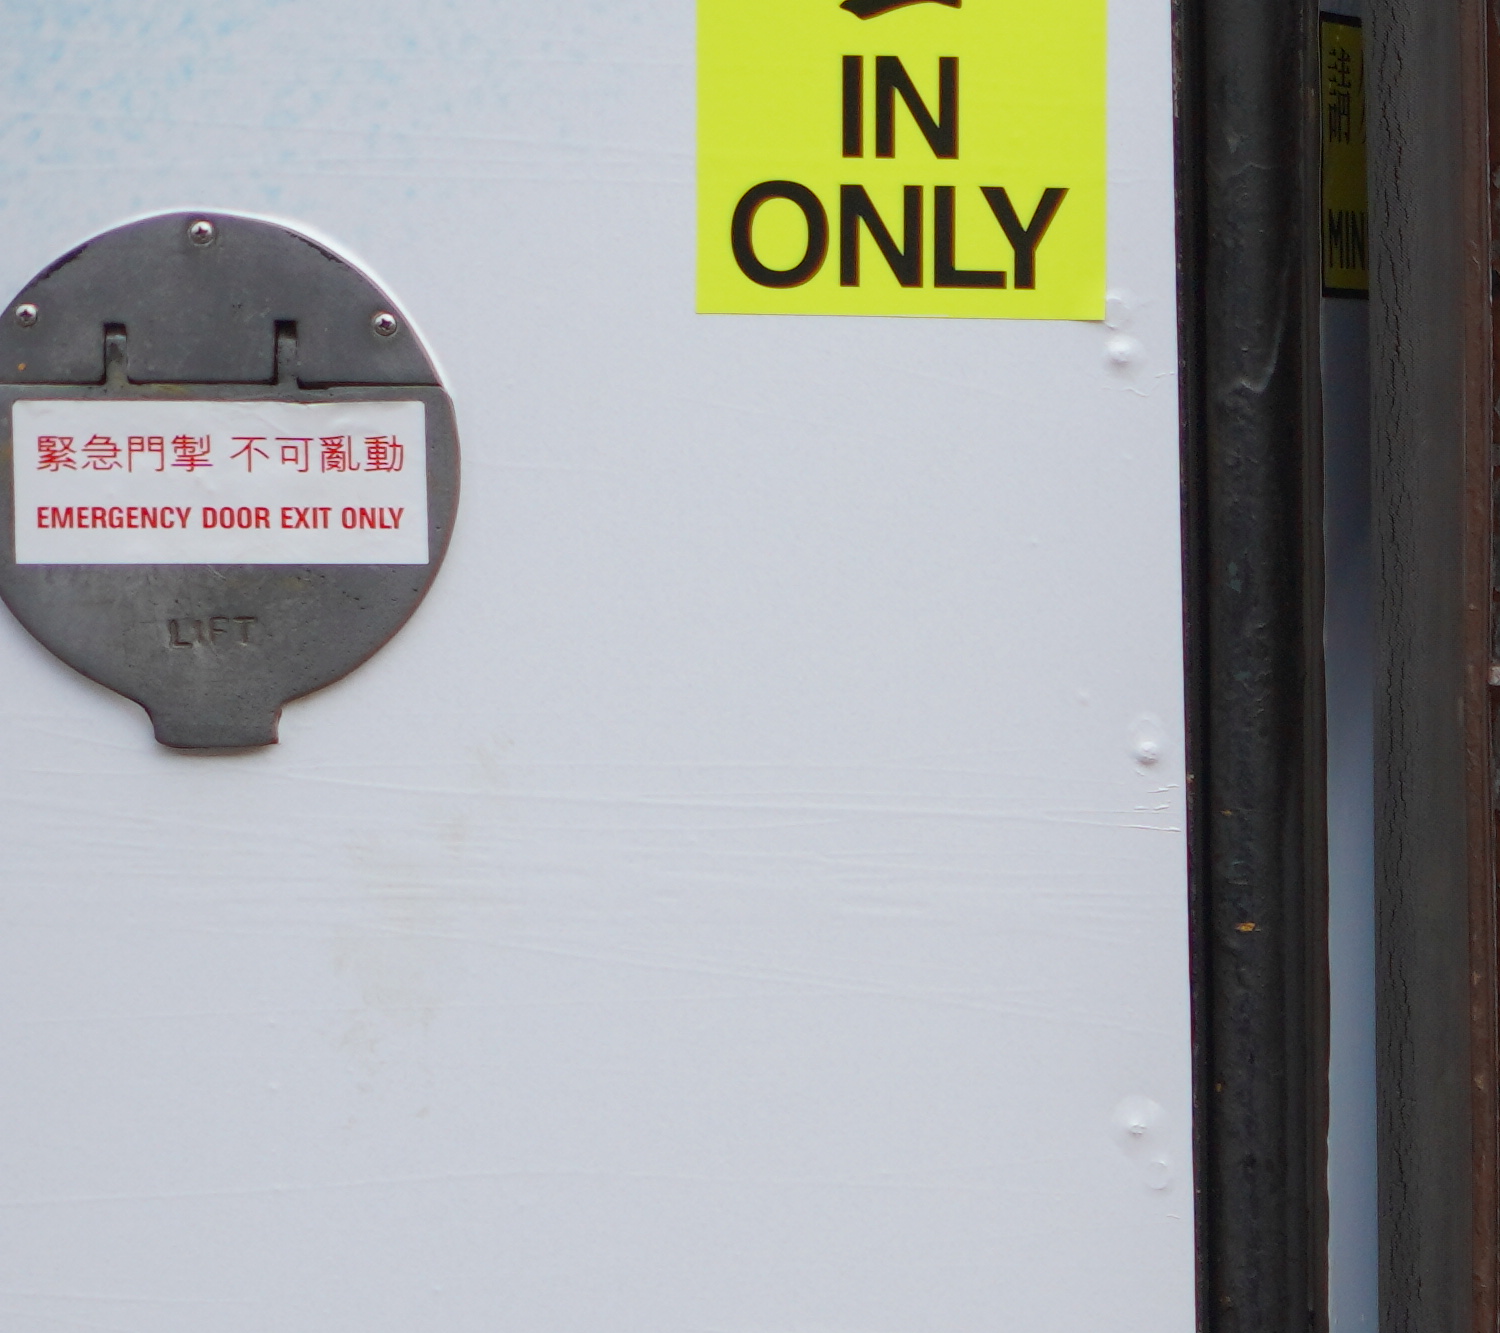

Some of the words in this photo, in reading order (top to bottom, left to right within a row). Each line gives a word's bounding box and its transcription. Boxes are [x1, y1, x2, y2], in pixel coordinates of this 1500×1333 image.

[841, 56, 958, 158] IN
[731, 181, 1069, 289] ONLY
[37, 507, 191, 529] EMERGENCY
[202, 507, 270, 529] DOOR
[281, 507, 331, 528] EXIT
[342, 507, 405, 529] ONLY
[168, 617, 258, 649] LIFT
